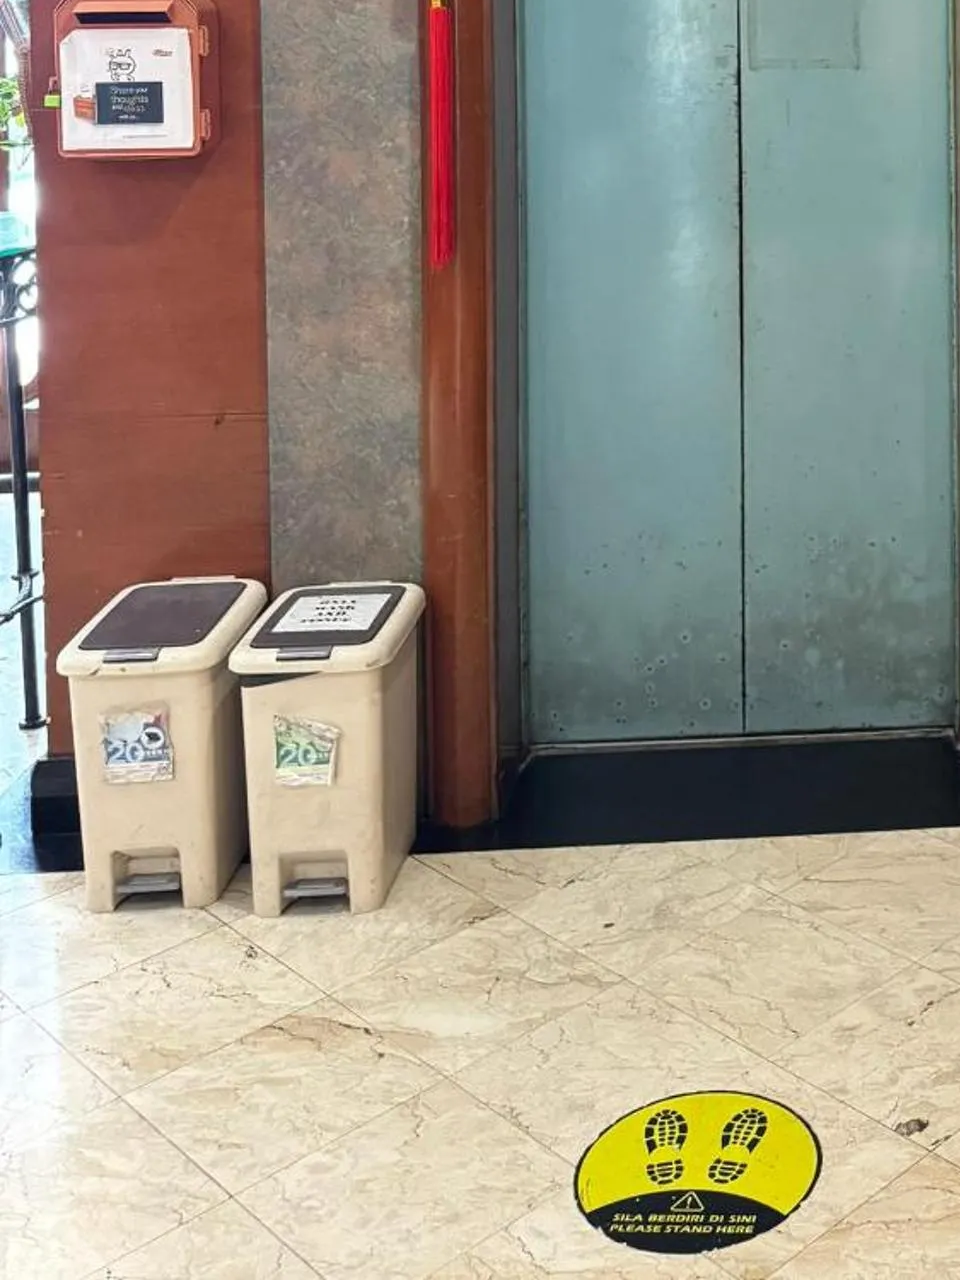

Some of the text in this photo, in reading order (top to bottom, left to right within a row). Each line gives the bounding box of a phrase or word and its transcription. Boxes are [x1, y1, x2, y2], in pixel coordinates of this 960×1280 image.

[612, 1212, 757, 1223] SILA BERDIRI DI SINI
[609, 1223, 754, 1234] PLEASE STAND HERE
